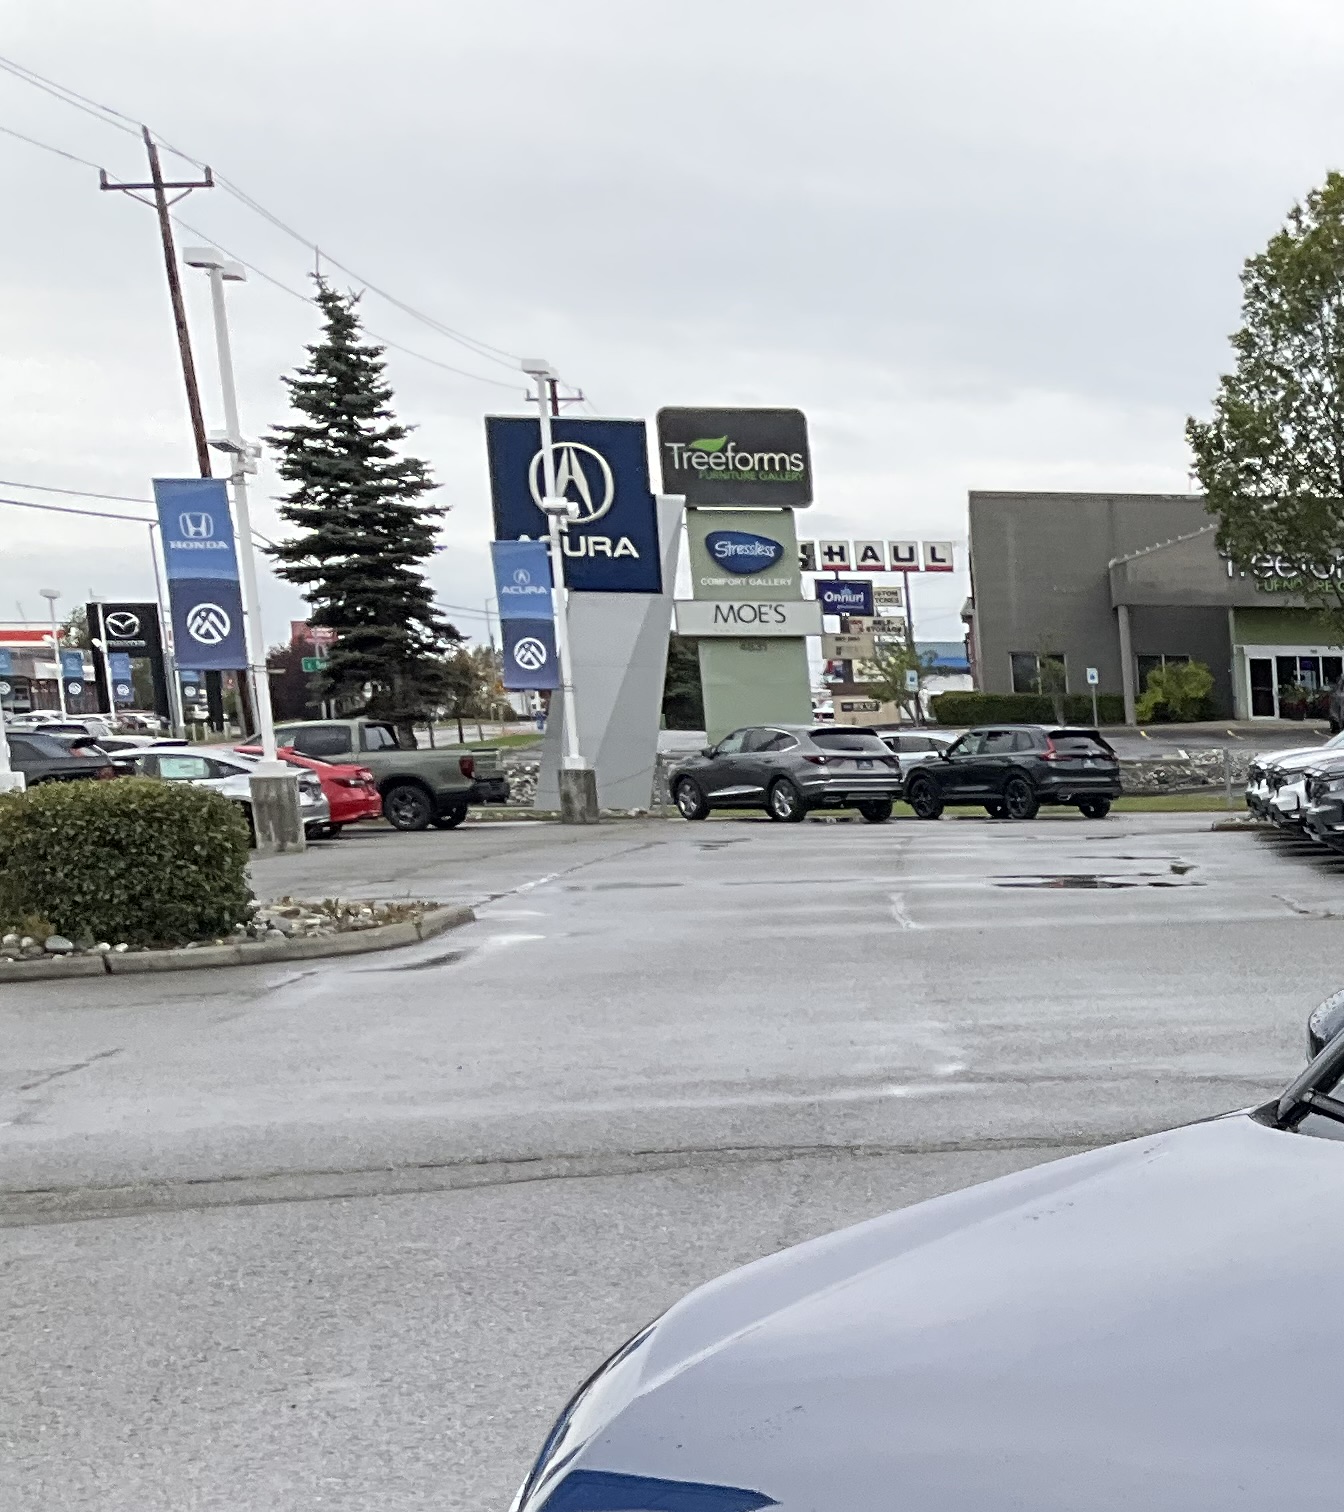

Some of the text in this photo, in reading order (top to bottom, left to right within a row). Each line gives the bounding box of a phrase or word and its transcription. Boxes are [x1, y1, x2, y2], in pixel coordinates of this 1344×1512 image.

[664, 441, 804, 471] Treeforms
[699, 470, 805, 481] FURNITURE GALLERY
[168, 540, 230, 550] HONDA
[714, 541, 776, 558] Stressless
[700, 577, 792, 586] COMFORT GALLERY
[501, 585, 548, 595] ACURA
[713, 603, 787, 624] MOE'S
